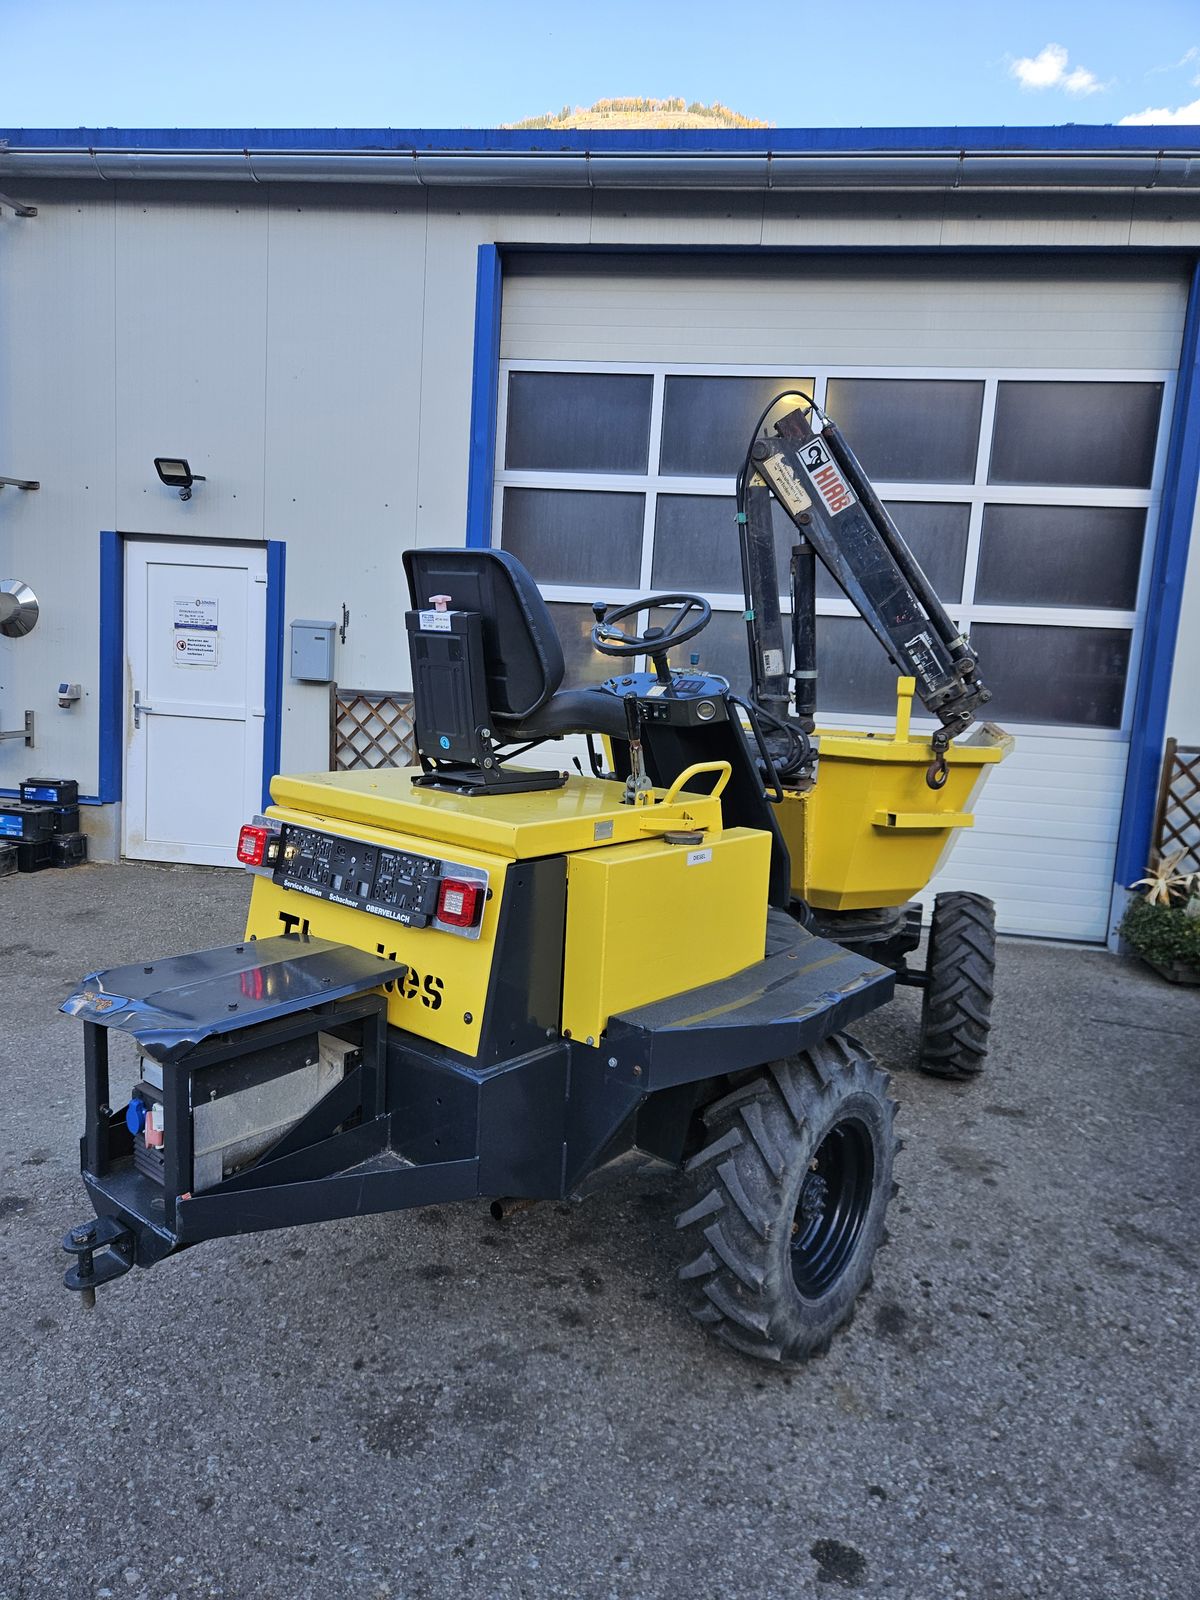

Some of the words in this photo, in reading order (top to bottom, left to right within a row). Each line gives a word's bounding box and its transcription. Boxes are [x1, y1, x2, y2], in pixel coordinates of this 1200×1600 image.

[813, 465, 851, 512] HIAB
[283, 879, 322, 897] Service-Station
[328, 893, 359, 908] Schachner
[365, 904, 411, 923] OBERVELLACH
